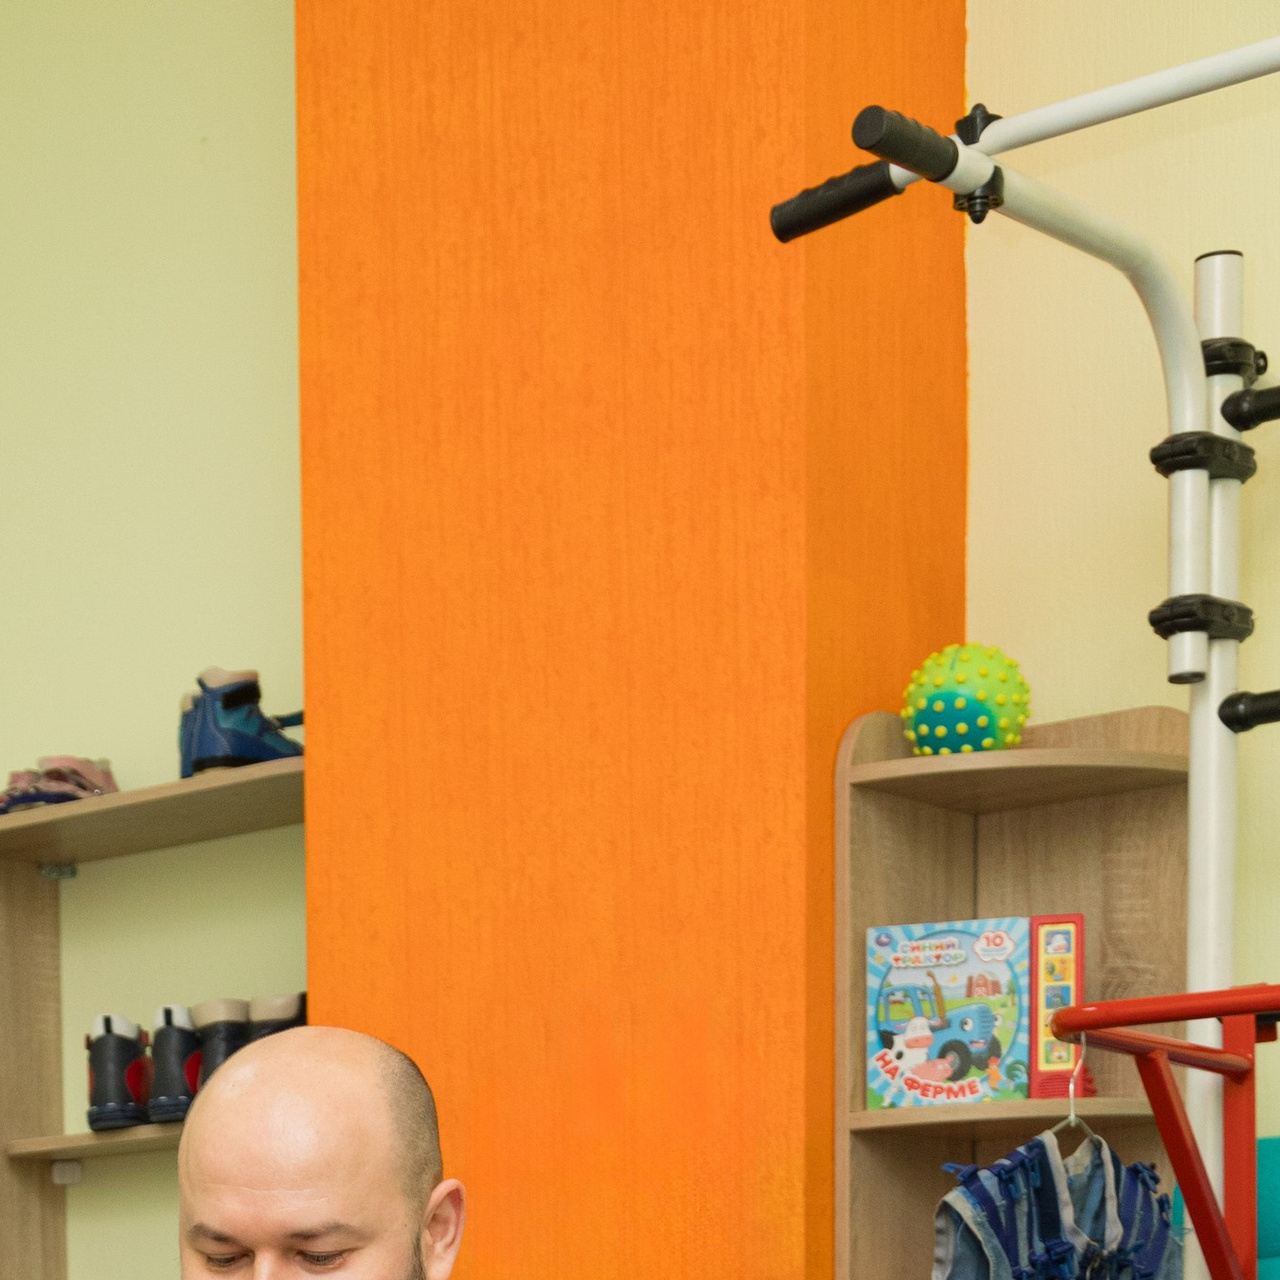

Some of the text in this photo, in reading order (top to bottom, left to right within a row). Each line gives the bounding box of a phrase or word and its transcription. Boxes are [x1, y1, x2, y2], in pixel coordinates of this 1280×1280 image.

[901, 940, 956, 953] СИНИЙ
[983, 935, 1004, 947] 10
[893, 952, 962, 964] ТРАКТОР
[875, 1051, 979, 1099] НА ФЕРМЕ
